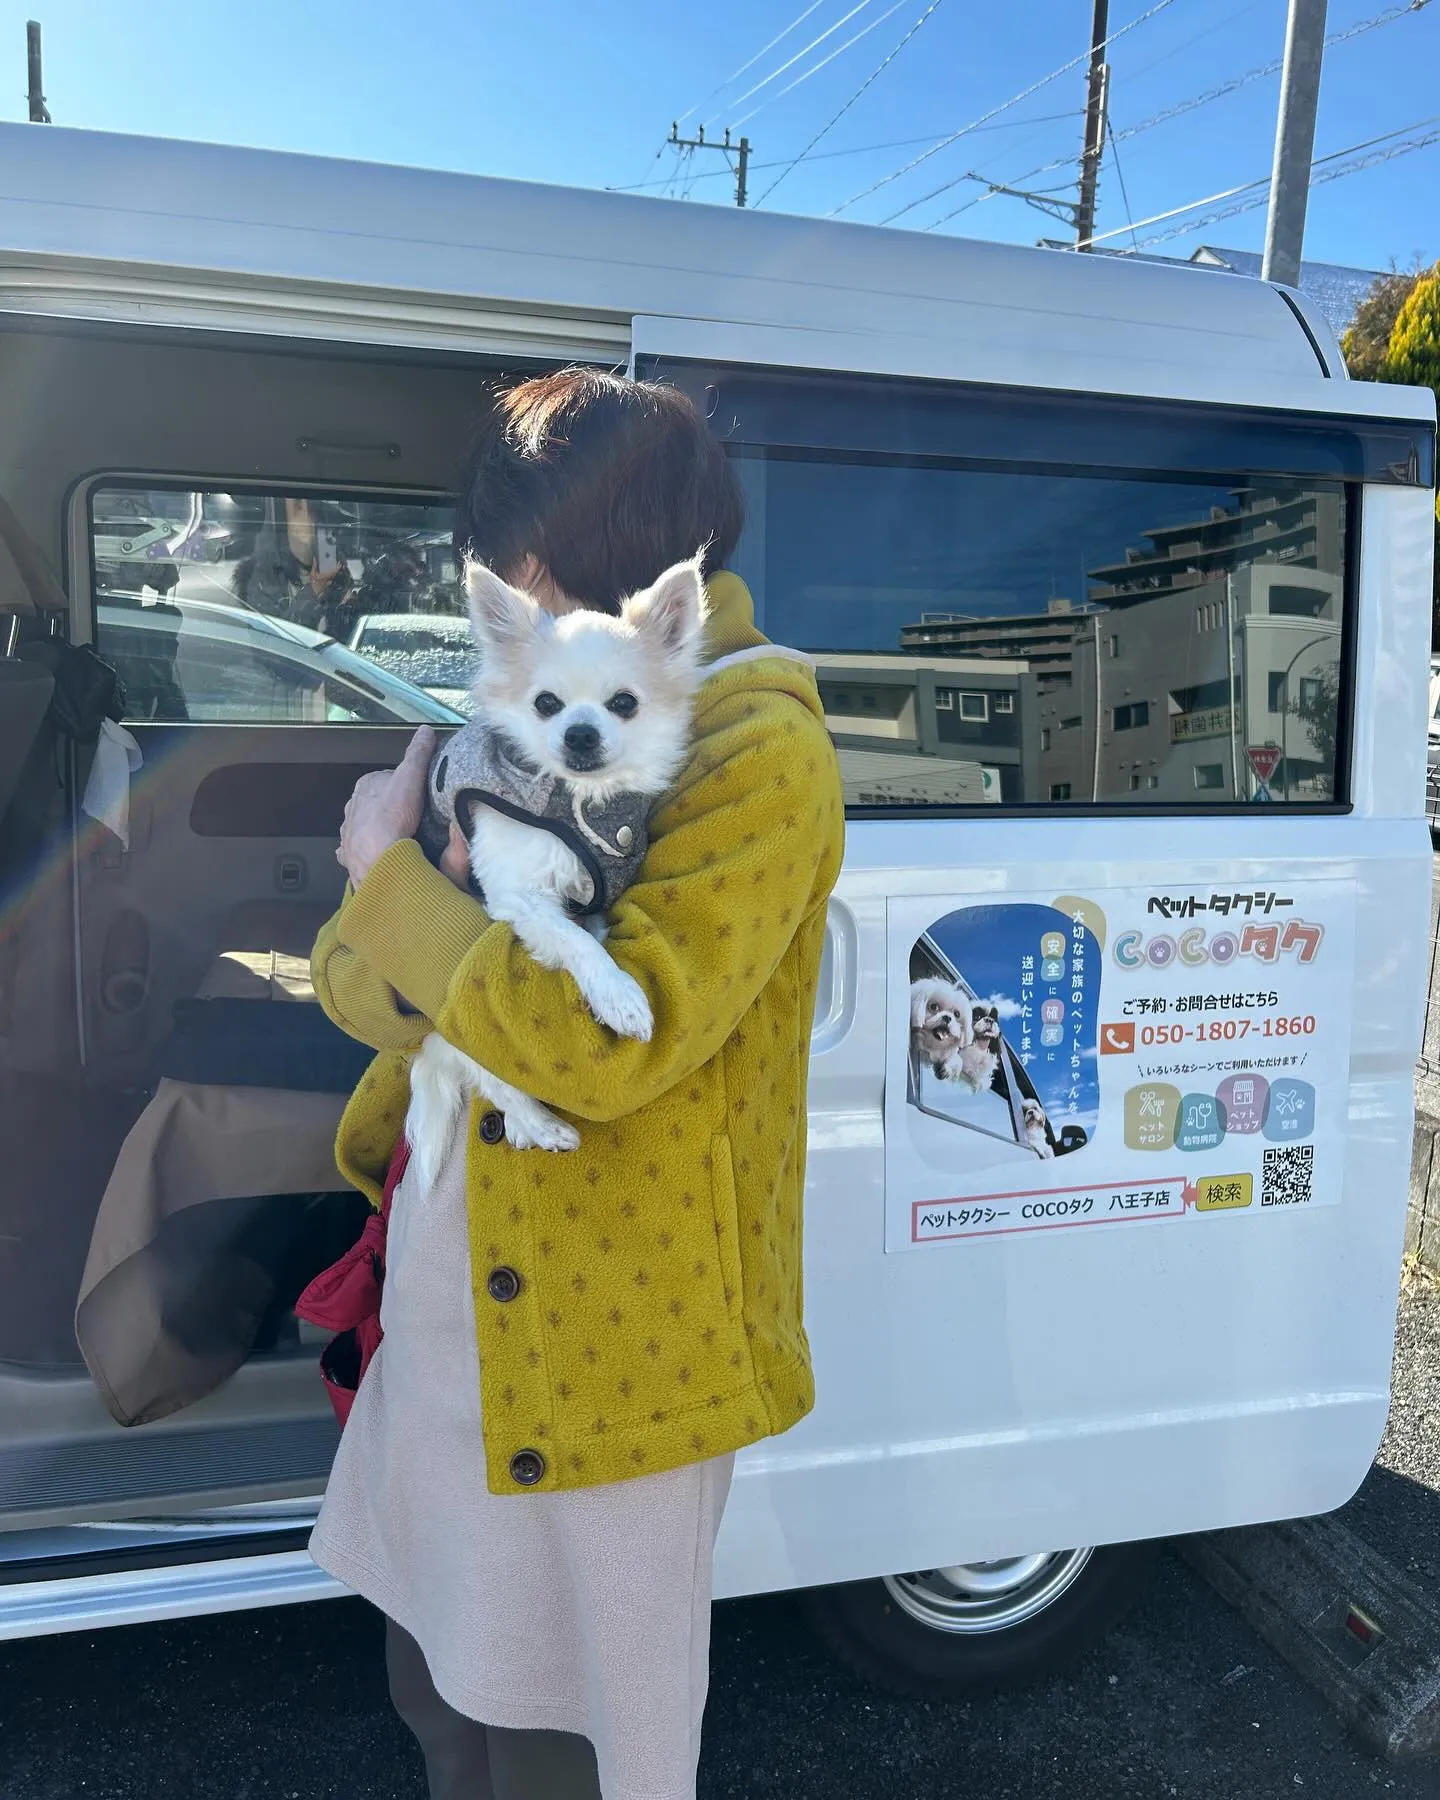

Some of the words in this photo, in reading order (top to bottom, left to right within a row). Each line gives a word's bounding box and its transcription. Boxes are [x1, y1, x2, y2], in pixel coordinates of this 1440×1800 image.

[1147, 891, 1294, 918] ペットタクシー
[1115, 919, 1326, 968] COCOタク
[1020, 955, 1034, 1067] 送迎いたします
[1069, 908, 1085, 1114] 大切な家族のペットちゃんを
[1122, 991, 1278, 1015] ご予約・お問合せはこちら
[1141, 1016, 1316, 1046] 050-1807-1860
[1146, 1056, 1299, 1075] いろいろなシーンでご利用いただけます
[1226, 1121, 1260, 1132] ショップ
[1230, 1110, 1256, 1121] ペット
[1138, 1122, 1165, 1132] ペット
[1138, 1134, 1164, 1144] サロン
[1183, 1133, 1218, 1146] 動物病院
[1206, 1182, 1242, 1203] 検索
[920, 1208, 1010, 1228] ペットタクシー
[1021, 1198, 1094, 1219] COCOタク
[1108, 1190, 1170, 1211] 八王子店
